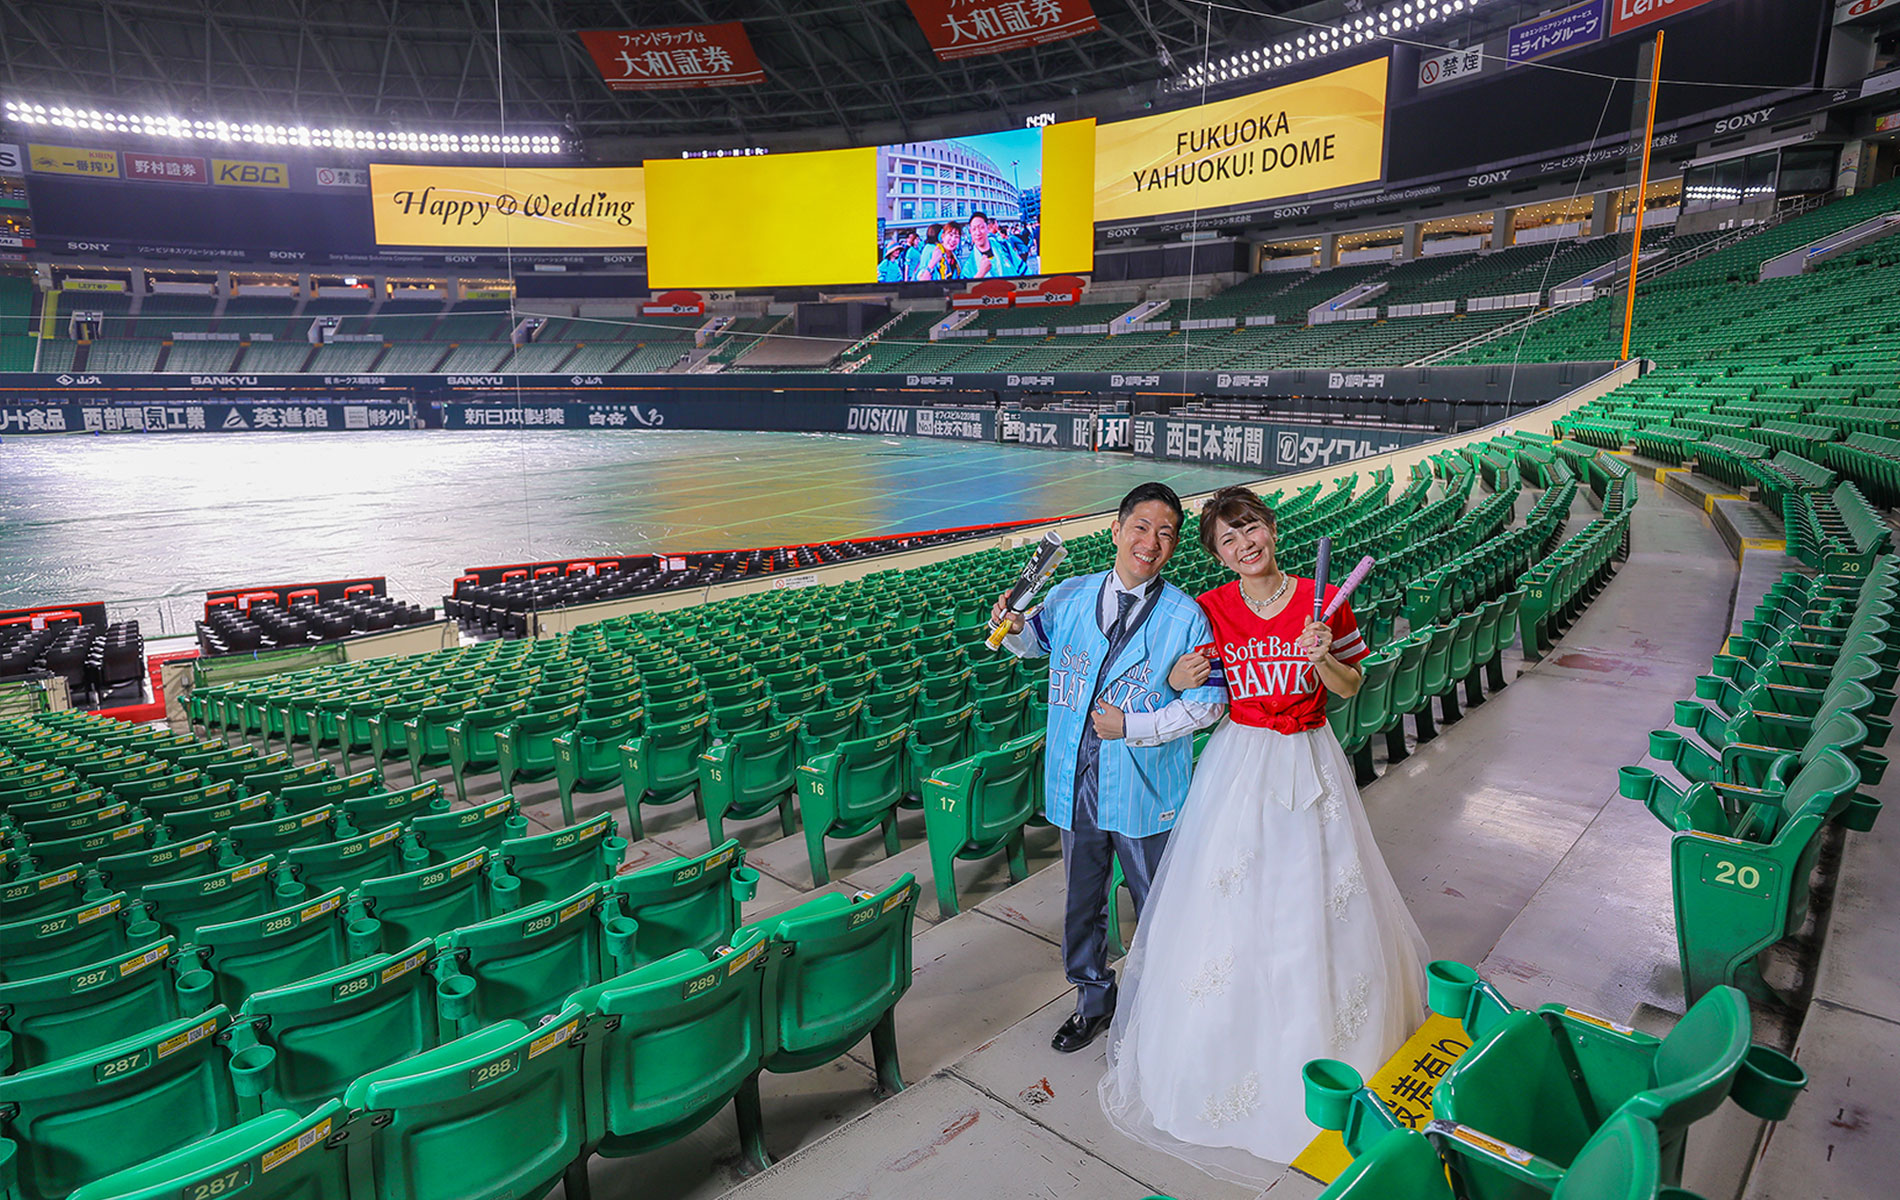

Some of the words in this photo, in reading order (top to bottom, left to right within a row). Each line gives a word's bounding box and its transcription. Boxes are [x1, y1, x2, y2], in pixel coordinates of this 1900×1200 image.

[941, 0, 1063, 44] 大和証券
[618, 29, 707, 47] ファンドラップは
[1510, 17, 1599, 57] ミライトグループ
[614, 46, 734, 77] 大和証券
[1442, 49, 1479, 77] 禁煙
[1026, 113, 1056, 128] 14:04
[1714, 107, 1775, 134] SONY
[1177, 110, 1290, 155] FUKUOKA
[89, 151, 114, 160] KIRIN
[1540, 133, 1678, 172] ソニービジネスソリューション式会社
[62, 160, 115, 173] 一番搾り
[134, 159, 197, 177] 野村證券
[1132, 152, 1255, 192] YAHUOKU!
[1262, 134, 1337, 173] DOME
[220, 164, 280, 183] KBC
[1467, 170, 1511, 187] SONY
[1404, 186, 1441, 198] Corporation
[393, 187, 490, 225] Happy
[524, 192, 635, 225] Wedding
[1274, 206, 1310, 219] SONY
[1107, 228, 1139, 238] SONY
[68, 241, 110, 251] SONY
[269, 250, 306, 260] SONY
[445, 255, 477, 263] SONY
[76, 376, 102, 385] 山九
[190, 376, 258, 385] SANKYU
[447, 377, 503, 385] SANKYU
[252, 407, 328, 427] 英進館
[465, 407, 565, 425] 新日本製薬
[847, 407, 909, 433] DUSKIN
[934, 420, 982, 438] 住友不動産
[1166, 421, 1265, 465] 西日本新聞
[1842, 562, 1860, 573] 20
[1420, 595, 1431, 604] 17
[1530, 590, 1543, 599] 18
[1224, 635, 1308, 663] SoftBan
[562, 751, 570, 762] 13
[629, 759, 639, 770] 14
[711, 769, 722, 782] 15
[811, 782, 825, 796] 16
[941, 797, 956, 813] 17
[462, 813, 479, 824] 290
[279, 822, 297, 833] 289
[86, 838, 105, 848] 287
[556, 834, 575, 847] 290
[344, 844, 363, 855] 289
[344, 844, 363, 855] 289
[153, 852, 173, 863] 288
[423, 873, 445, 886] 289
[678, 867, 698, 881] 290
[1715, 861, 1760, 889] 20
[6, 886, 29, 898] 287
[204, 879, 226, 891] 288
[851, 908, 874, 925] 290
[41, 920, 67, 934] 287
[267, 917, 292, 932] 288
[529, 917, 552, 933] 289
[77, 970, 107, 988] 287
[689, 974, 716, 995] 289
[339, 979, 369, 997] 288
[104, 1055, 141, 1077] 287
[478, 1059, 511, 1082] 288
[195, 1171, 240, 1200] 287
